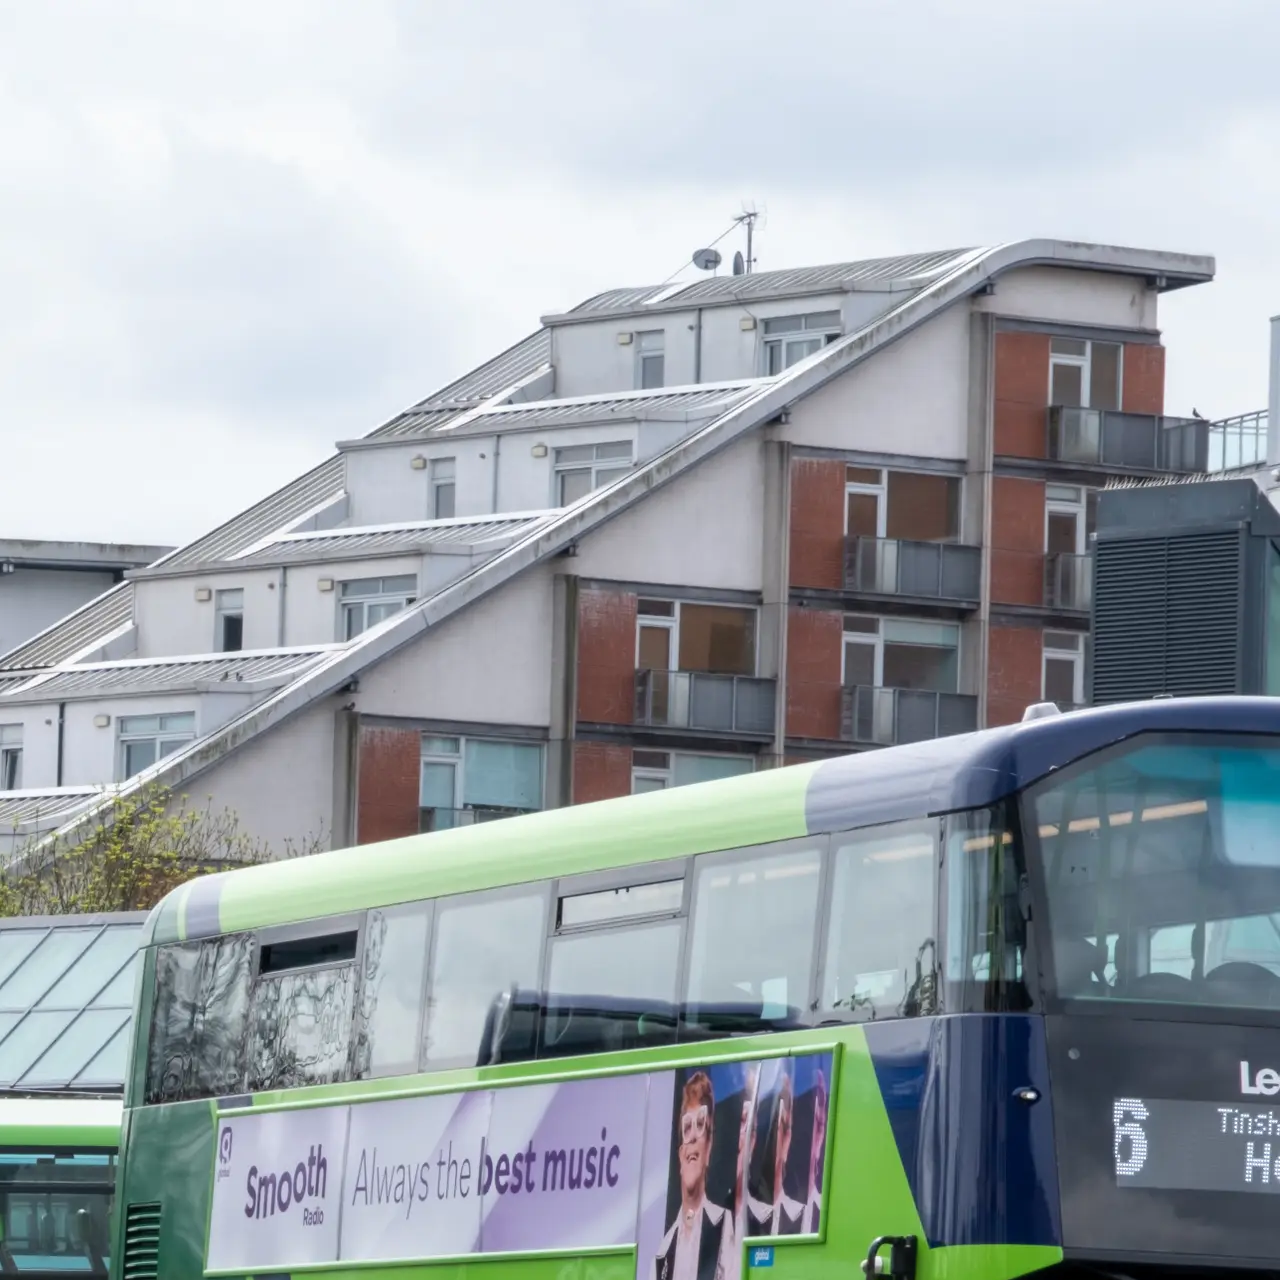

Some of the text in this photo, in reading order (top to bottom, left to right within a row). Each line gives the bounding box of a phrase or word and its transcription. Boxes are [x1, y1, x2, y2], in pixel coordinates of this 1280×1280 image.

[1240, 1061, 1280, 1095] Le
[352, 1127, 620, 1220] Always the best music
[1114, 1098, 1149, 1176] 6
[245, 1144, 327, 1219] Smooth
[303, 1206, 324, 1226] Radio
